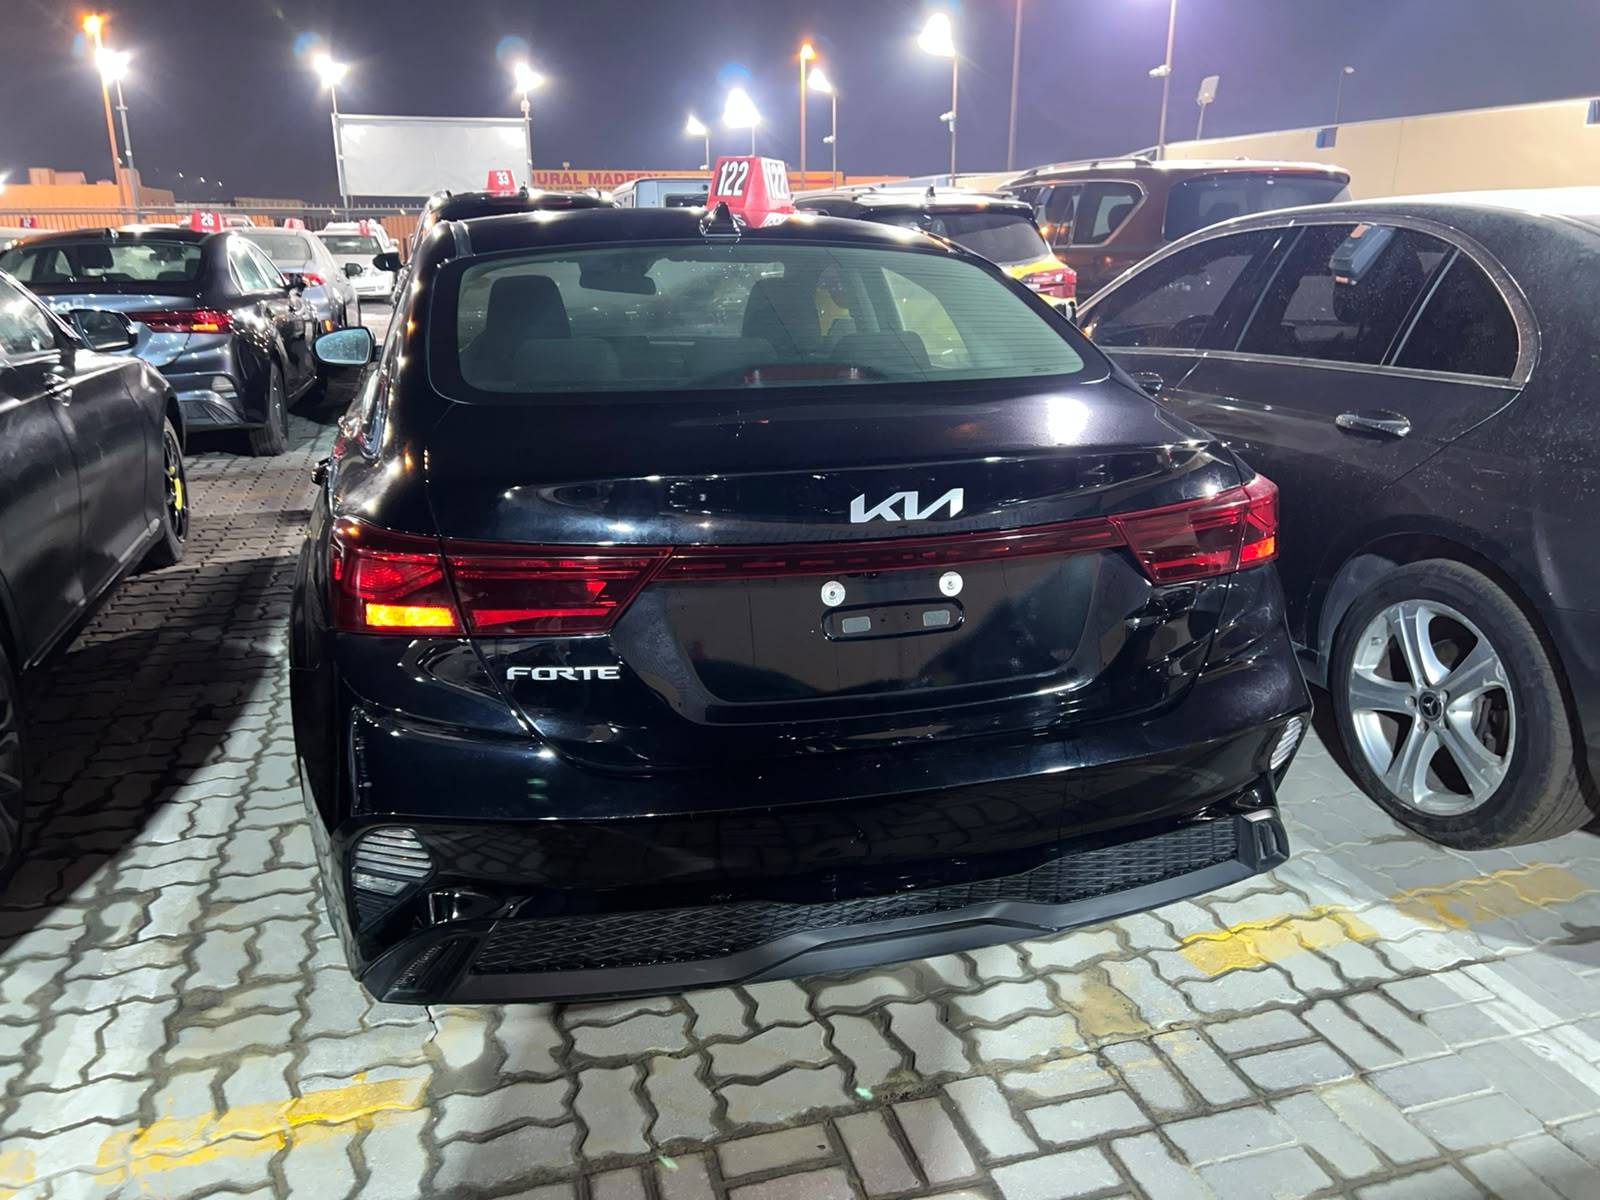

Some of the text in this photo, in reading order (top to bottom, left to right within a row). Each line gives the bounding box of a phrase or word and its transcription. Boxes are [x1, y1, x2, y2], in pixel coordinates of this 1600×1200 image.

[496, 171, 510, 186] 33
[532, 172, 583, 185] URAL
[717, 160, 750, 197] 122
[200, 211, 215, 227] 26
[850, 487, 965, 524] KIA
[506, 666, 621, 681] FORTE
